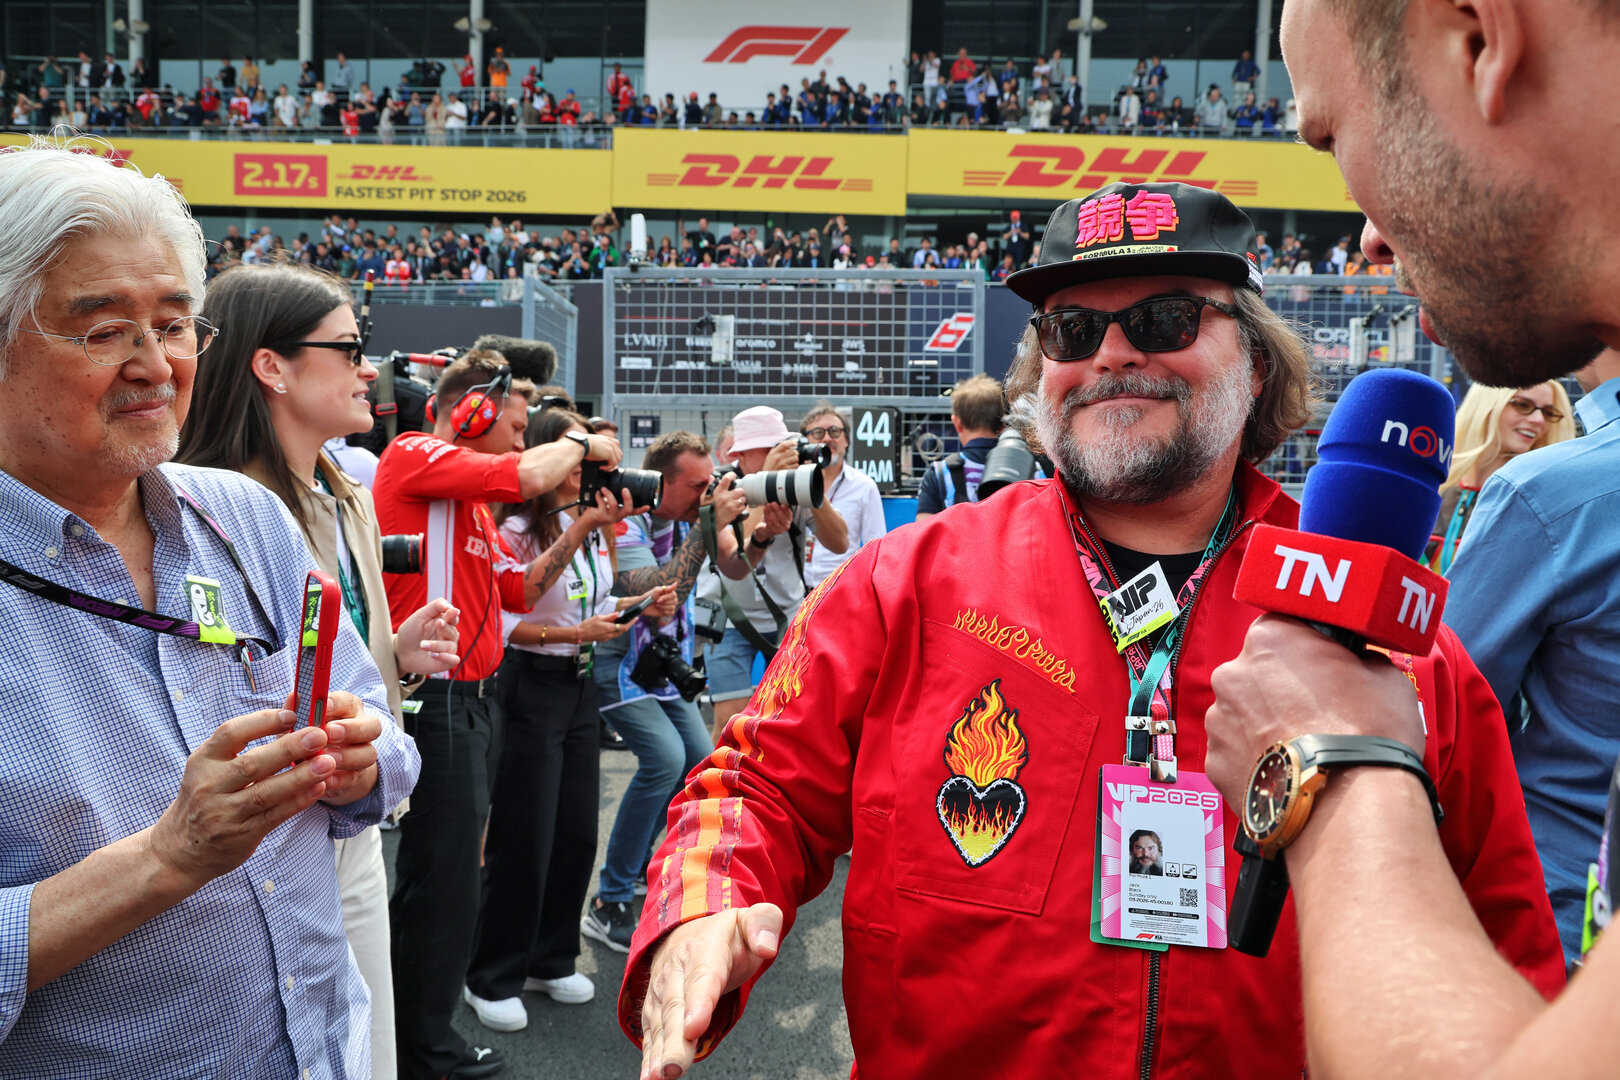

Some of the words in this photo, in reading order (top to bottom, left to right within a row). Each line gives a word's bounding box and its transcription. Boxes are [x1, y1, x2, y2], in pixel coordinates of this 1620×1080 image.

[702, 25, 851, 65] F1
[242, 162, 319, 189] 2.17s
[350, 165, 419, 181] DHL
[676, 153, 843, 190] DHL
[1003, 143, 1219, 190] DHL
[335, 186, 405, 200] FASTEST
[409, 187, 436, 200] PIT
[440, 189, 482, 202] STOP
[486, 190, 527, 203] 2026
[1083, 247, 1126, 260] FORMULA
[735, 339, 777, 349] aramco
[856, 408, 892, 447] 44
[854, 459, 894, 483] HAM
[1274, 544, 1352, 603] TN
[1106, 573, 1158, 617] VIP
[1396, 575, 1436, 635] TN
[1126, 645, 1147, 673] JAPA
